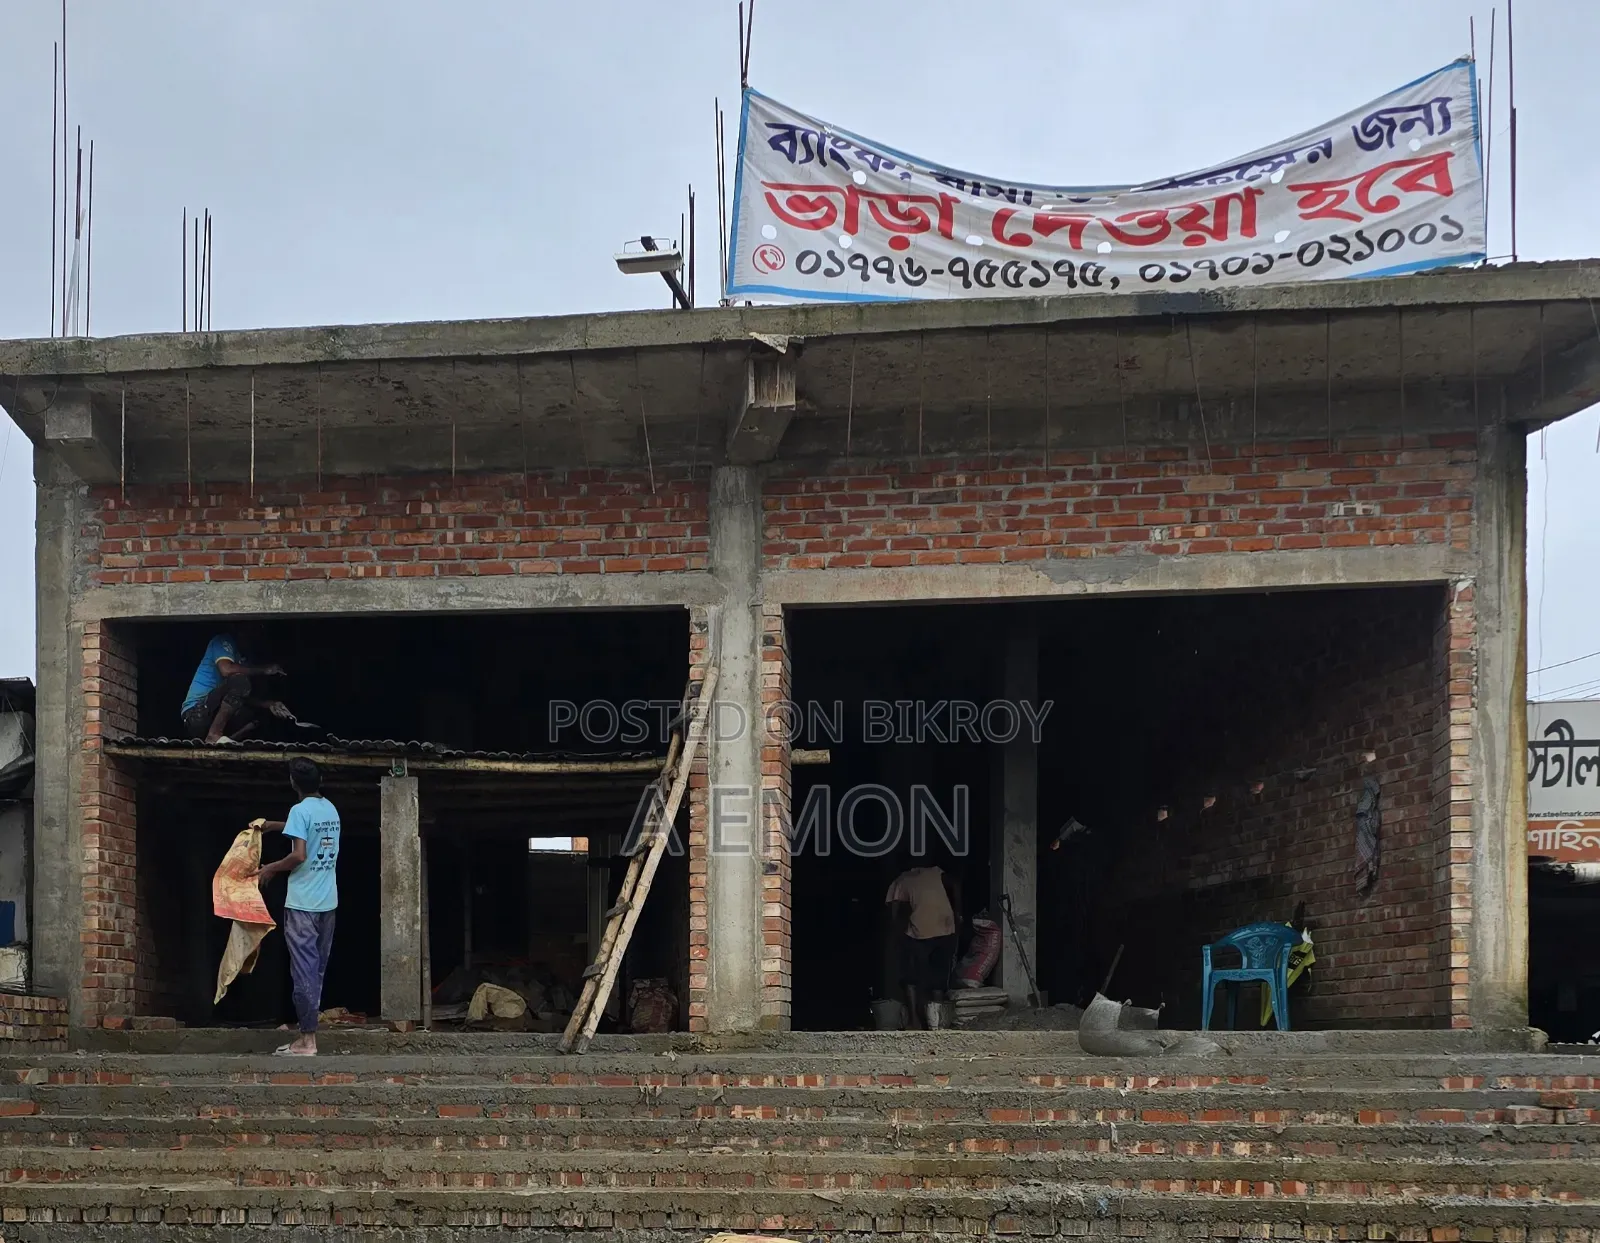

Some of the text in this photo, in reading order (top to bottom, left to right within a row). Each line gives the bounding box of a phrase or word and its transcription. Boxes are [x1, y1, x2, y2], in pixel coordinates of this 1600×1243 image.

[1352, 97, 1452, 151] জন্য
[761, 180, 961, 250] ভাড়া
[992, 185, 1264, 250] দেওয়া
[1286, 151, 1455, 223] হবে
[795, 214, 1464, 290] ০১৭৭৬-৭৫৫১৭৫, ০১৭০১-০২১০০১
